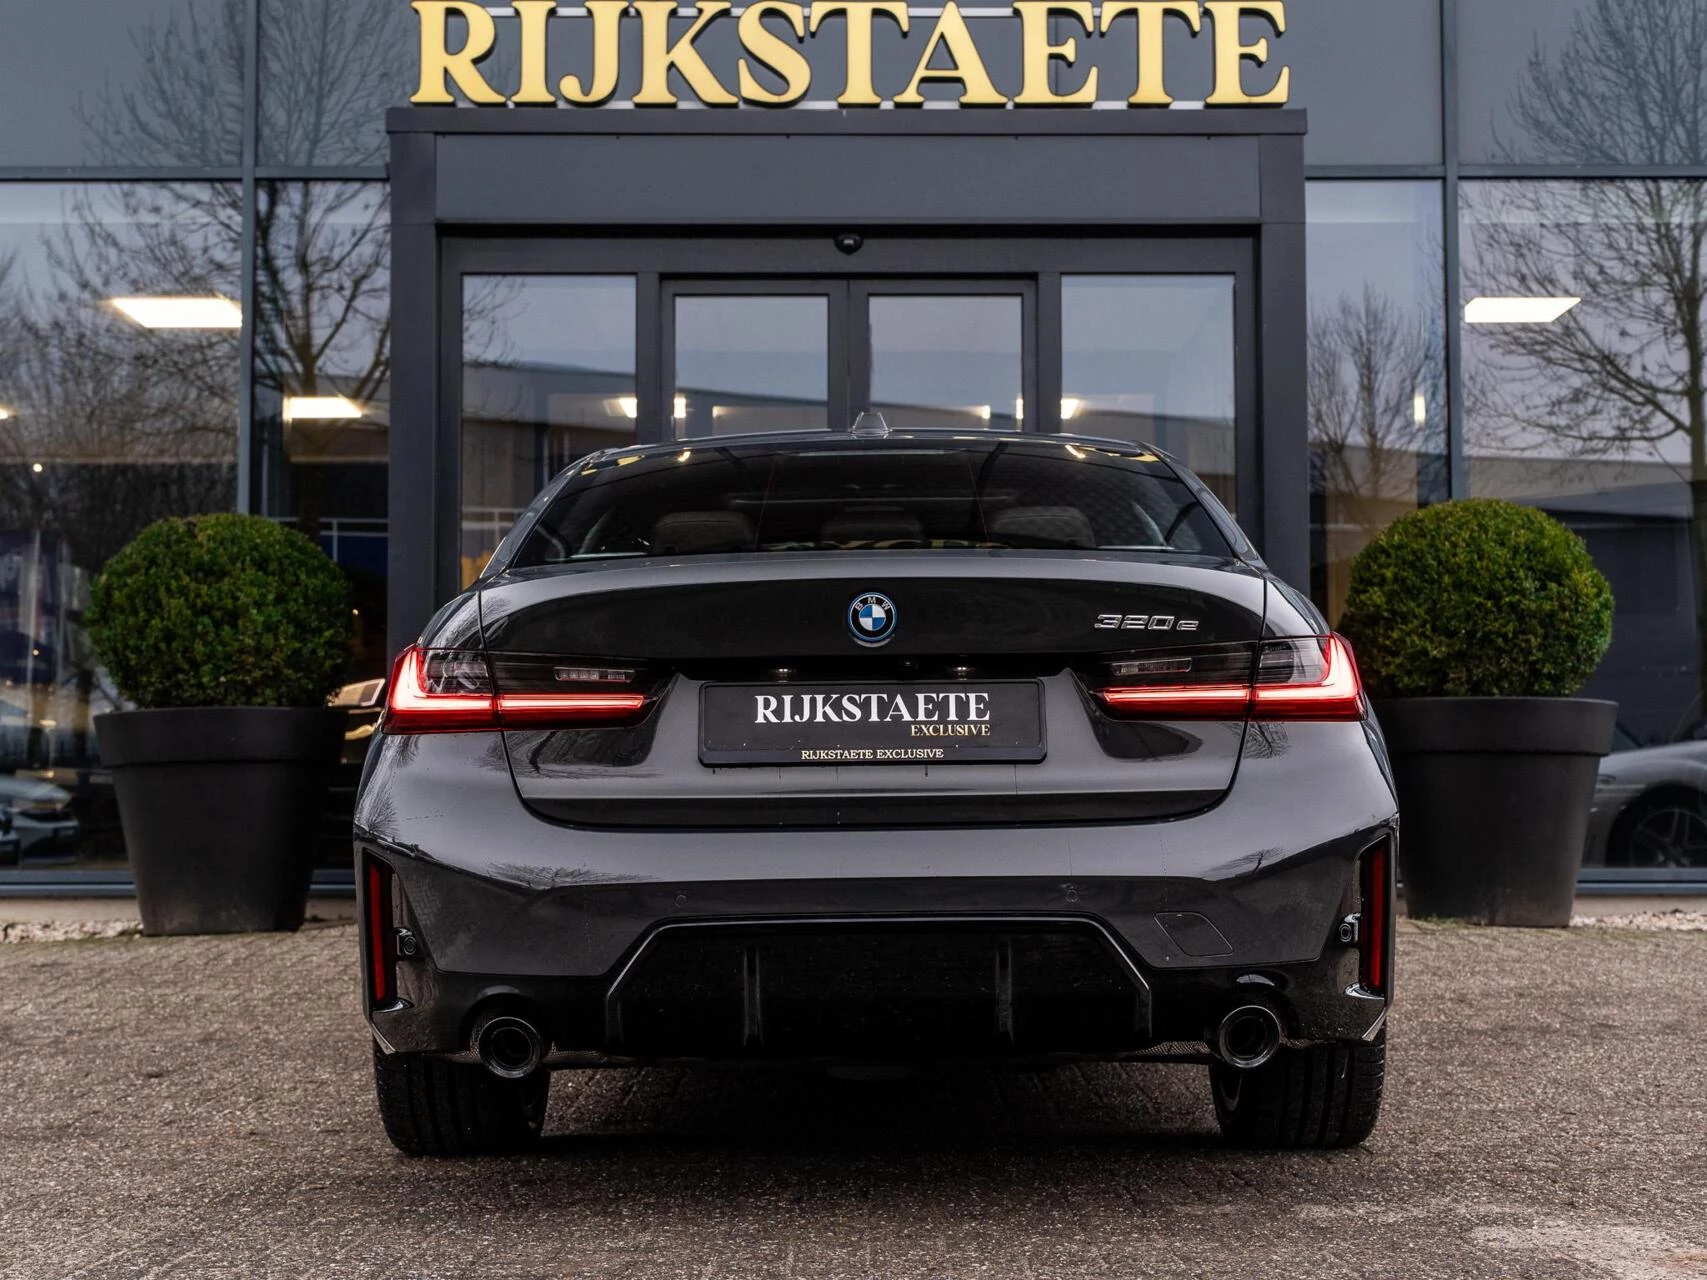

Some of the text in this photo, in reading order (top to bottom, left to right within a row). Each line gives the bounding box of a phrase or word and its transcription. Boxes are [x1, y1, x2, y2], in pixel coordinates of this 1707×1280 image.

[410, 0, 1291, 106] RIJKSTAETE
[854, 596, 890, 611] BMW
[1094, 614, 1199, 630] 320e
[754, 692, 990, 723] RIJKSTAETE
[910, 724, 991, 737] EXCLUSIVE
[800, 748, 945, 760] RIJKSTAETE EXCLUSIVE
